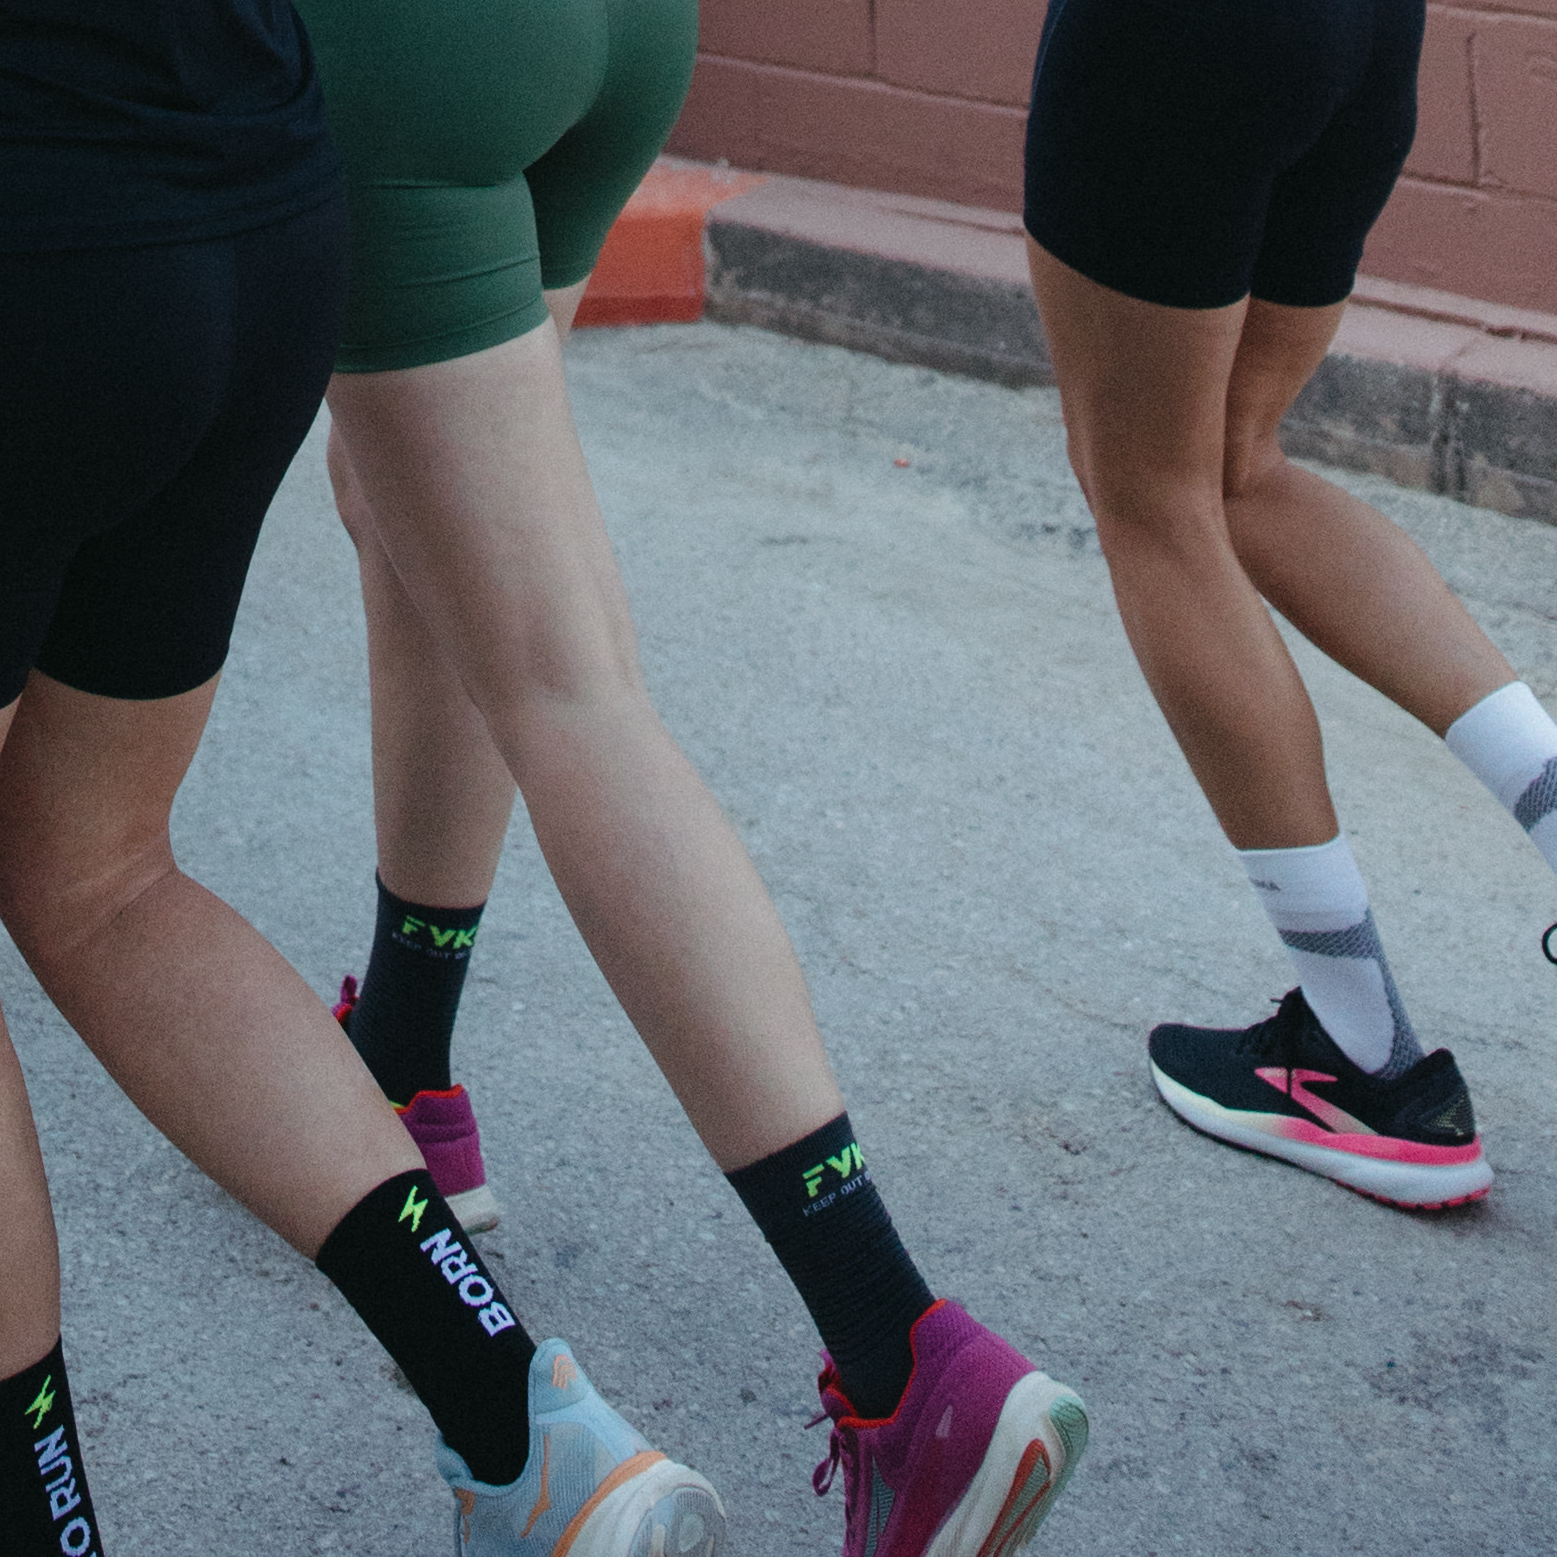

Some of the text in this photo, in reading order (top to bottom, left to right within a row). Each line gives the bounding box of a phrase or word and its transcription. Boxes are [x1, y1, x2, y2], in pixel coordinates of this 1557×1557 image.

[802, 1192, 837, 1218] KEEP
[840, 1174, 863, 1196] OUT
[420, 1227, 516, 1337] BORN
[34, 1424, 82, 1522] RUN
